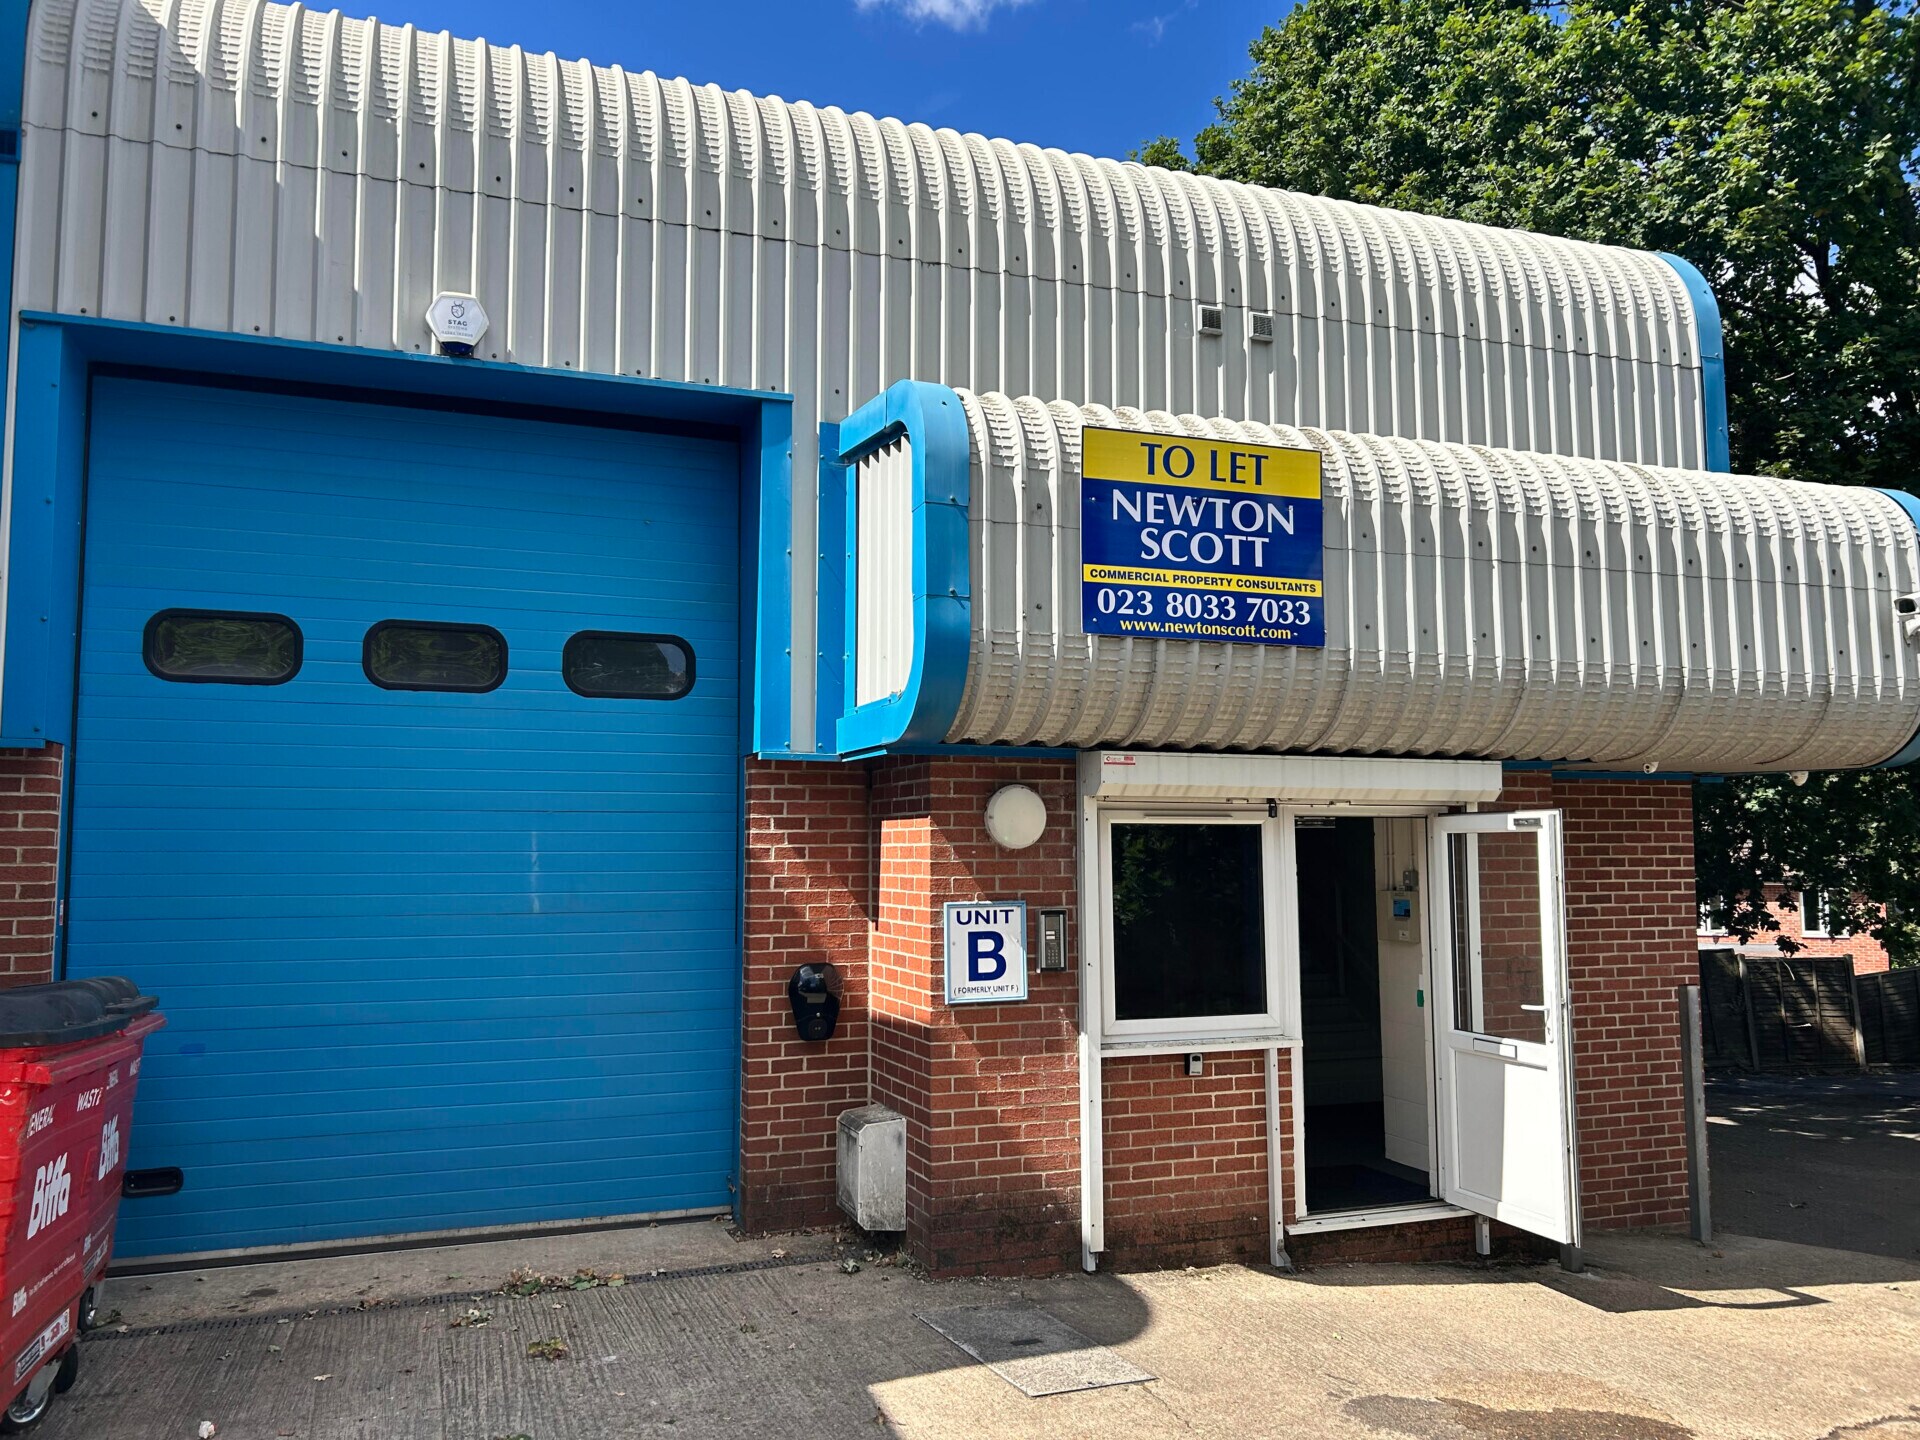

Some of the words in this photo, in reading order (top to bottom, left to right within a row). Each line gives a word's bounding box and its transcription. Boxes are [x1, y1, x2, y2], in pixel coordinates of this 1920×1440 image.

[1140, 442, 1195, 479] TO
[1210, 449, 1269, 486] LET
[1112, 488, 1294, 535] NEWTON
[1140, 527, 1270, 568] SCOTT
[1089, 568, 1170, 583] COMMERCIAL
[1172, 574, 1233, 588] PROPERTY
[1236, 578, 1317, 594] CONSULTANTS
[1097, 588, 1153, 616] 023
[1166, 592, 1237, 621] 8033
[1246, 597, 1311, 626] 7033
[1120, 619, 1292, 640] www.newtonscott.com
[956, 909, 1014, 926] UNIT
[967, 930, 1007, 982] B
[992, 984, 1009, 993] UNIT
[27, 1151, 71, 1240] Biffa
